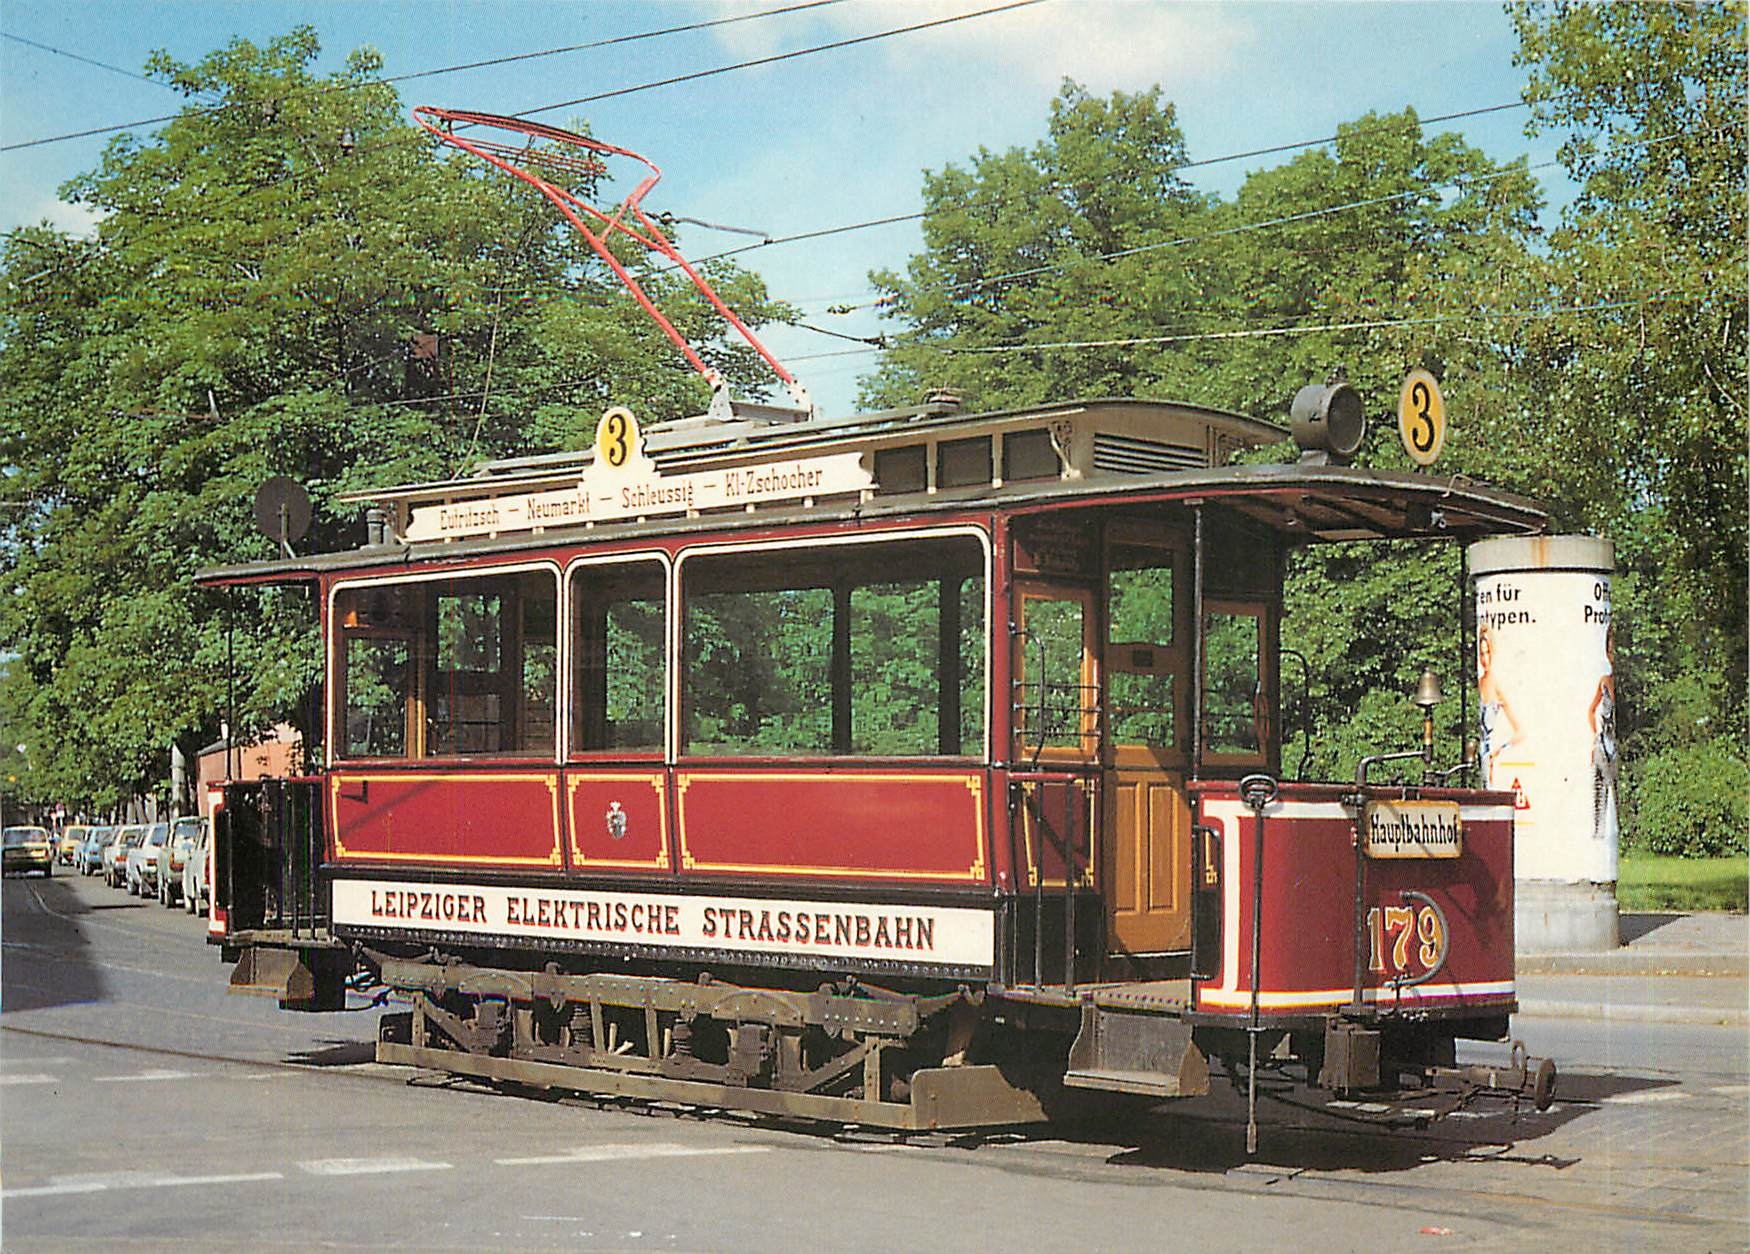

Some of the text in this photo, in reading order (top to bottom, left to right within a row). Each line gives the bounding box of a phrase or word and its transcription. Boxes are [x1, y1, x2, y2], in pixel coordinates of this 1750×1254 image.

[608, 413, 627, 467] 3
[1411, 381, 1435, 452] 3
[527, 492, 590, 520] Neumarkt
[1496, 583, 1522, 602] für
[1370, 814, 1459, 852] Hauptbahnhof
[371, 890, 936, 951] LEIPZIGER ELEKTRISCHE STRASSENBAHN
[1366, 906, 1445, 974] 179
